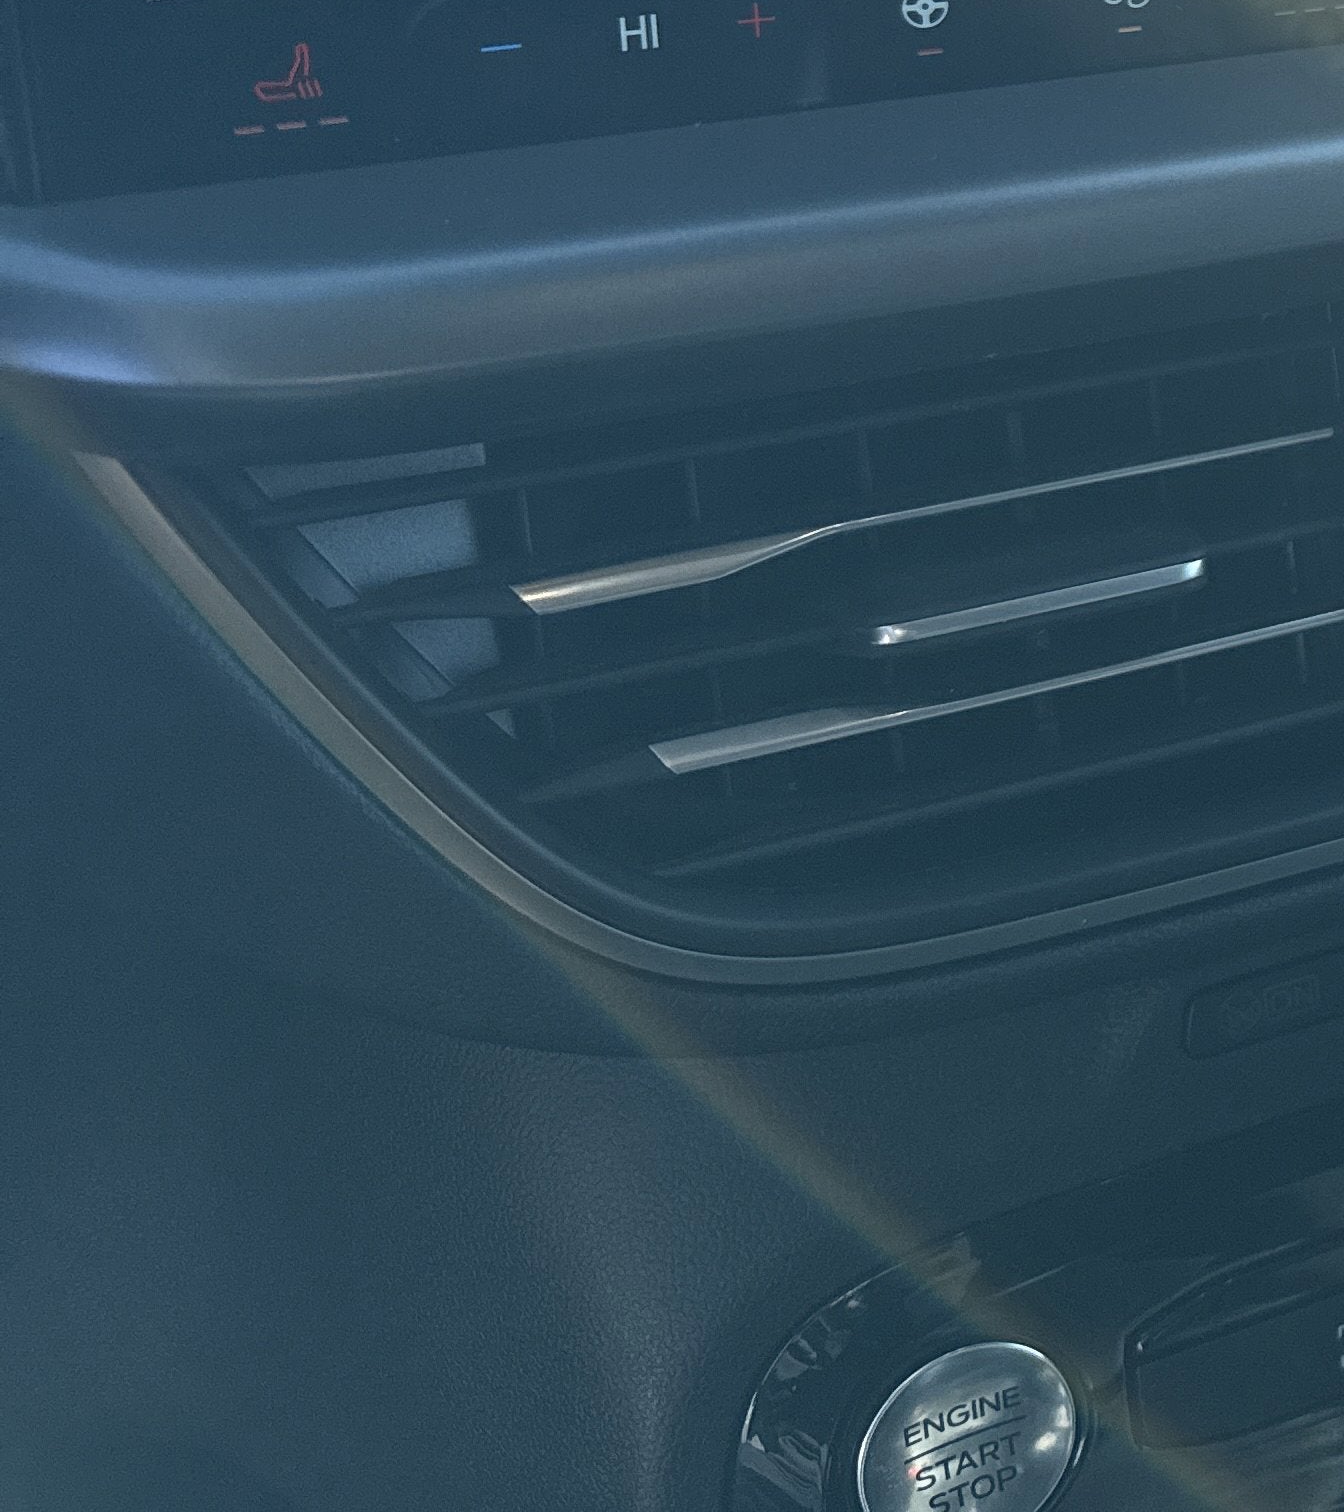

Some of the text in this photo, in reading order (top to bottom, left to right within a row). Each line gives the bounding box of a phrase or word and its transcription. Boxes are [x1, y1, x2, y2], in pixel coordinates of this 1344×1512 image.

[618, 14, 660, 52] HI
[904, 1386, 1022, 1447] ENGINE
[915, 1431, 1022, 1492] START
[929, 1465, 1018, 1512] STOP
